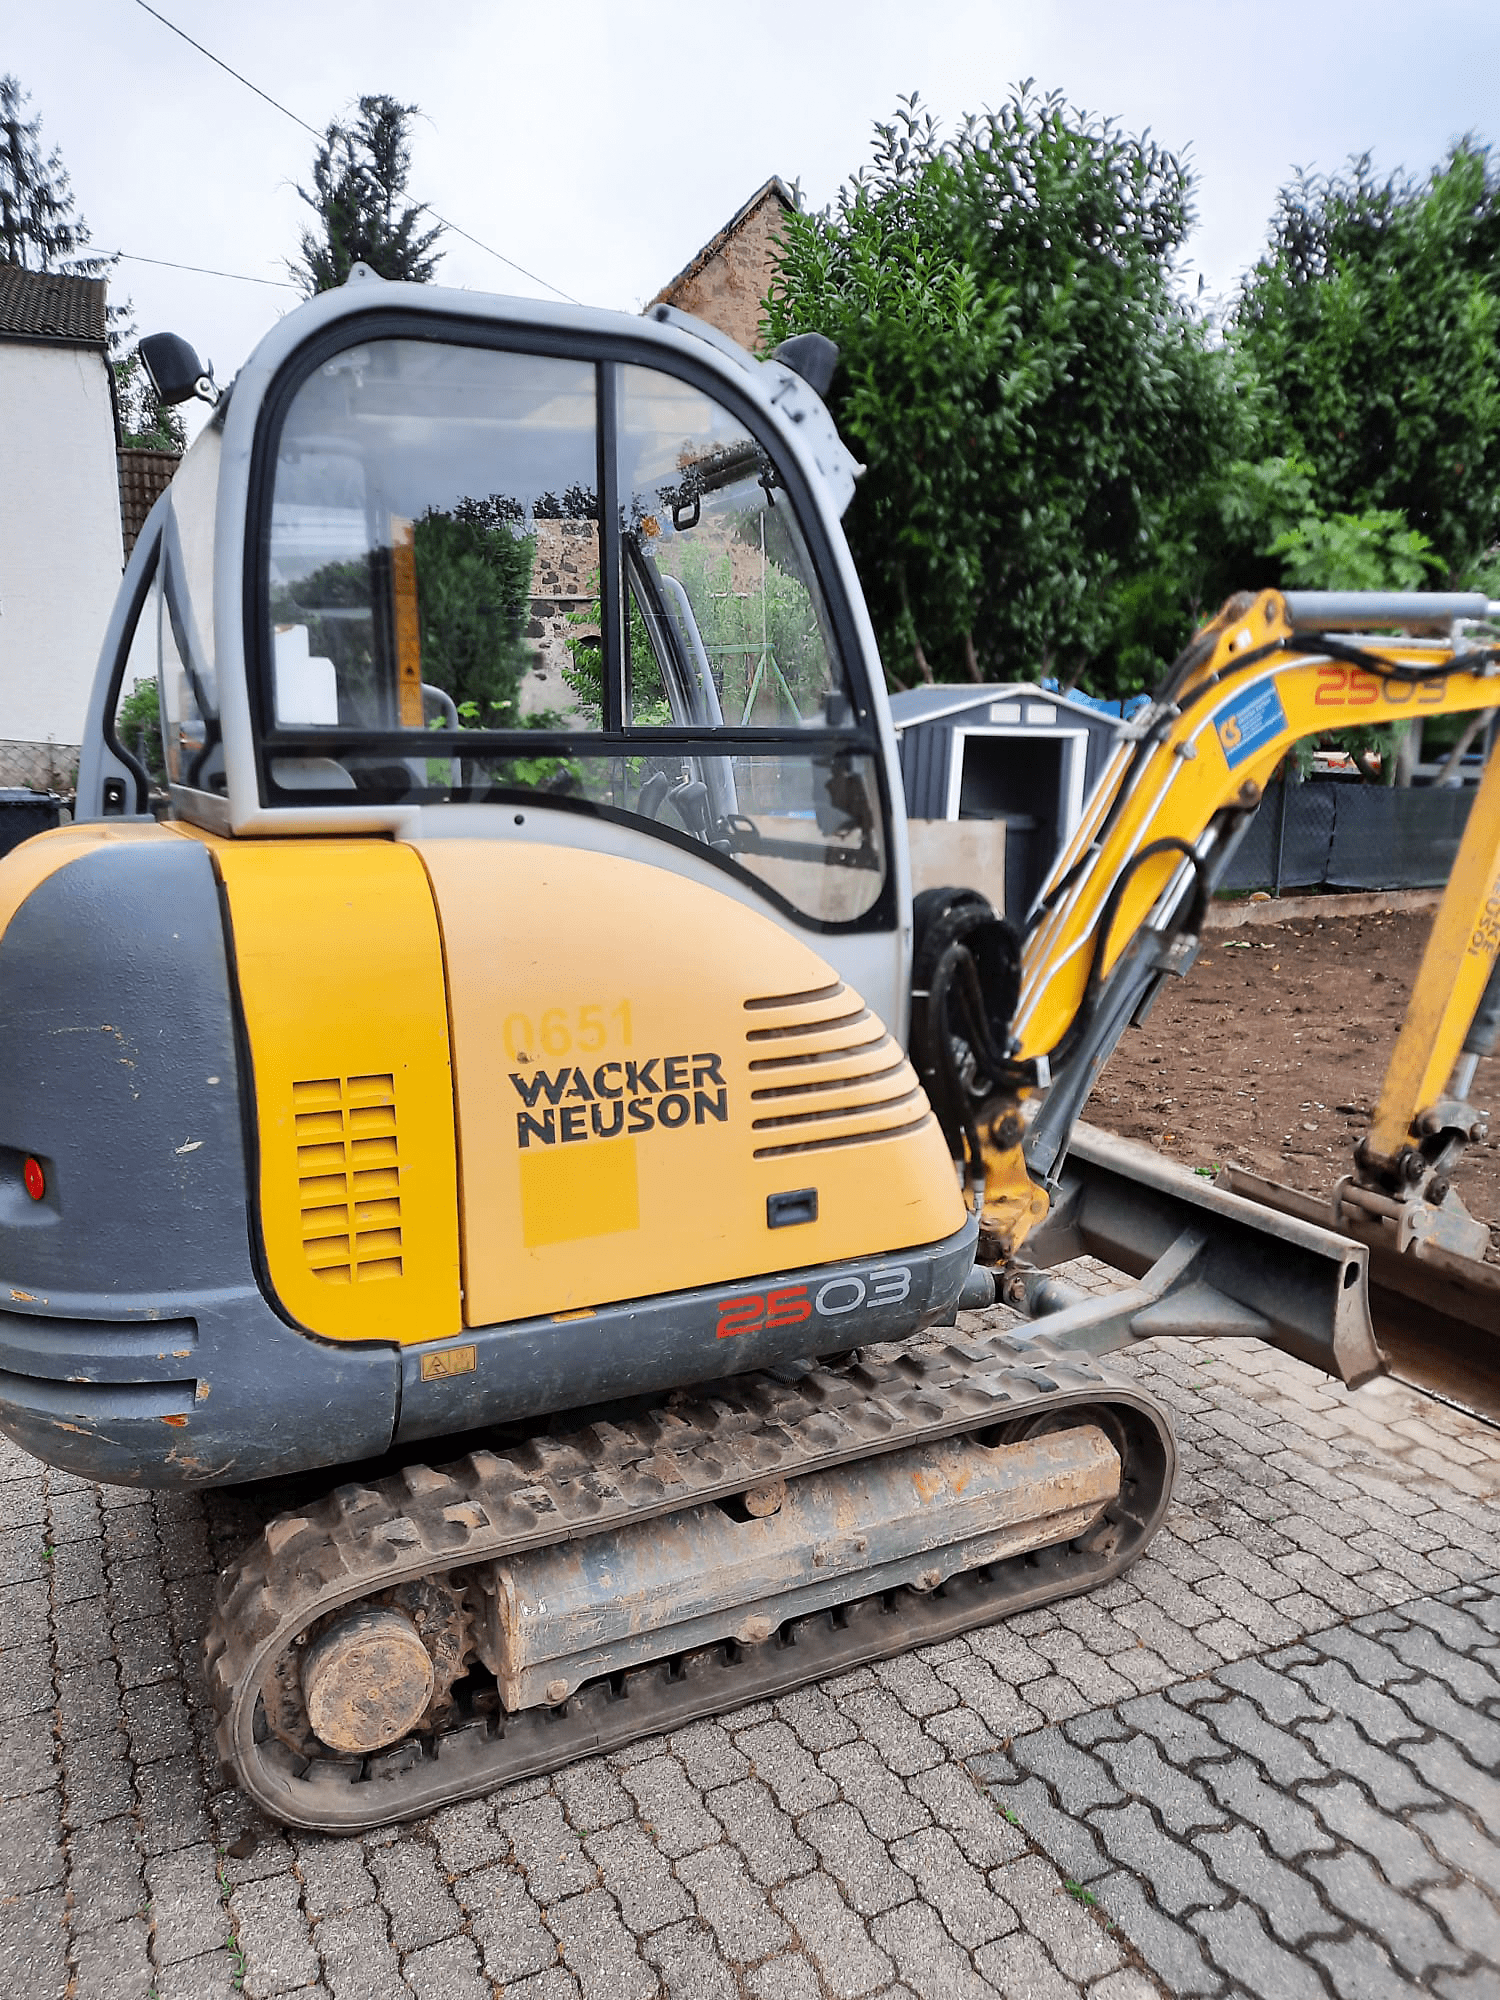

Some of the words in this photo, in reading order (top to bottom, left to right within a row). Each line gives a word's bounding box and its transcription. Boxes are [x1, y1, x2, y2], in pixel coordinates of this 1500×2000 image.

[502, 998, 632, 1063] 0651
[508, 1052, 727, 1108] WACKER
[516, 1088, 729, 1148] NEUSON
[716, 1266, 912, 1340] 2503
